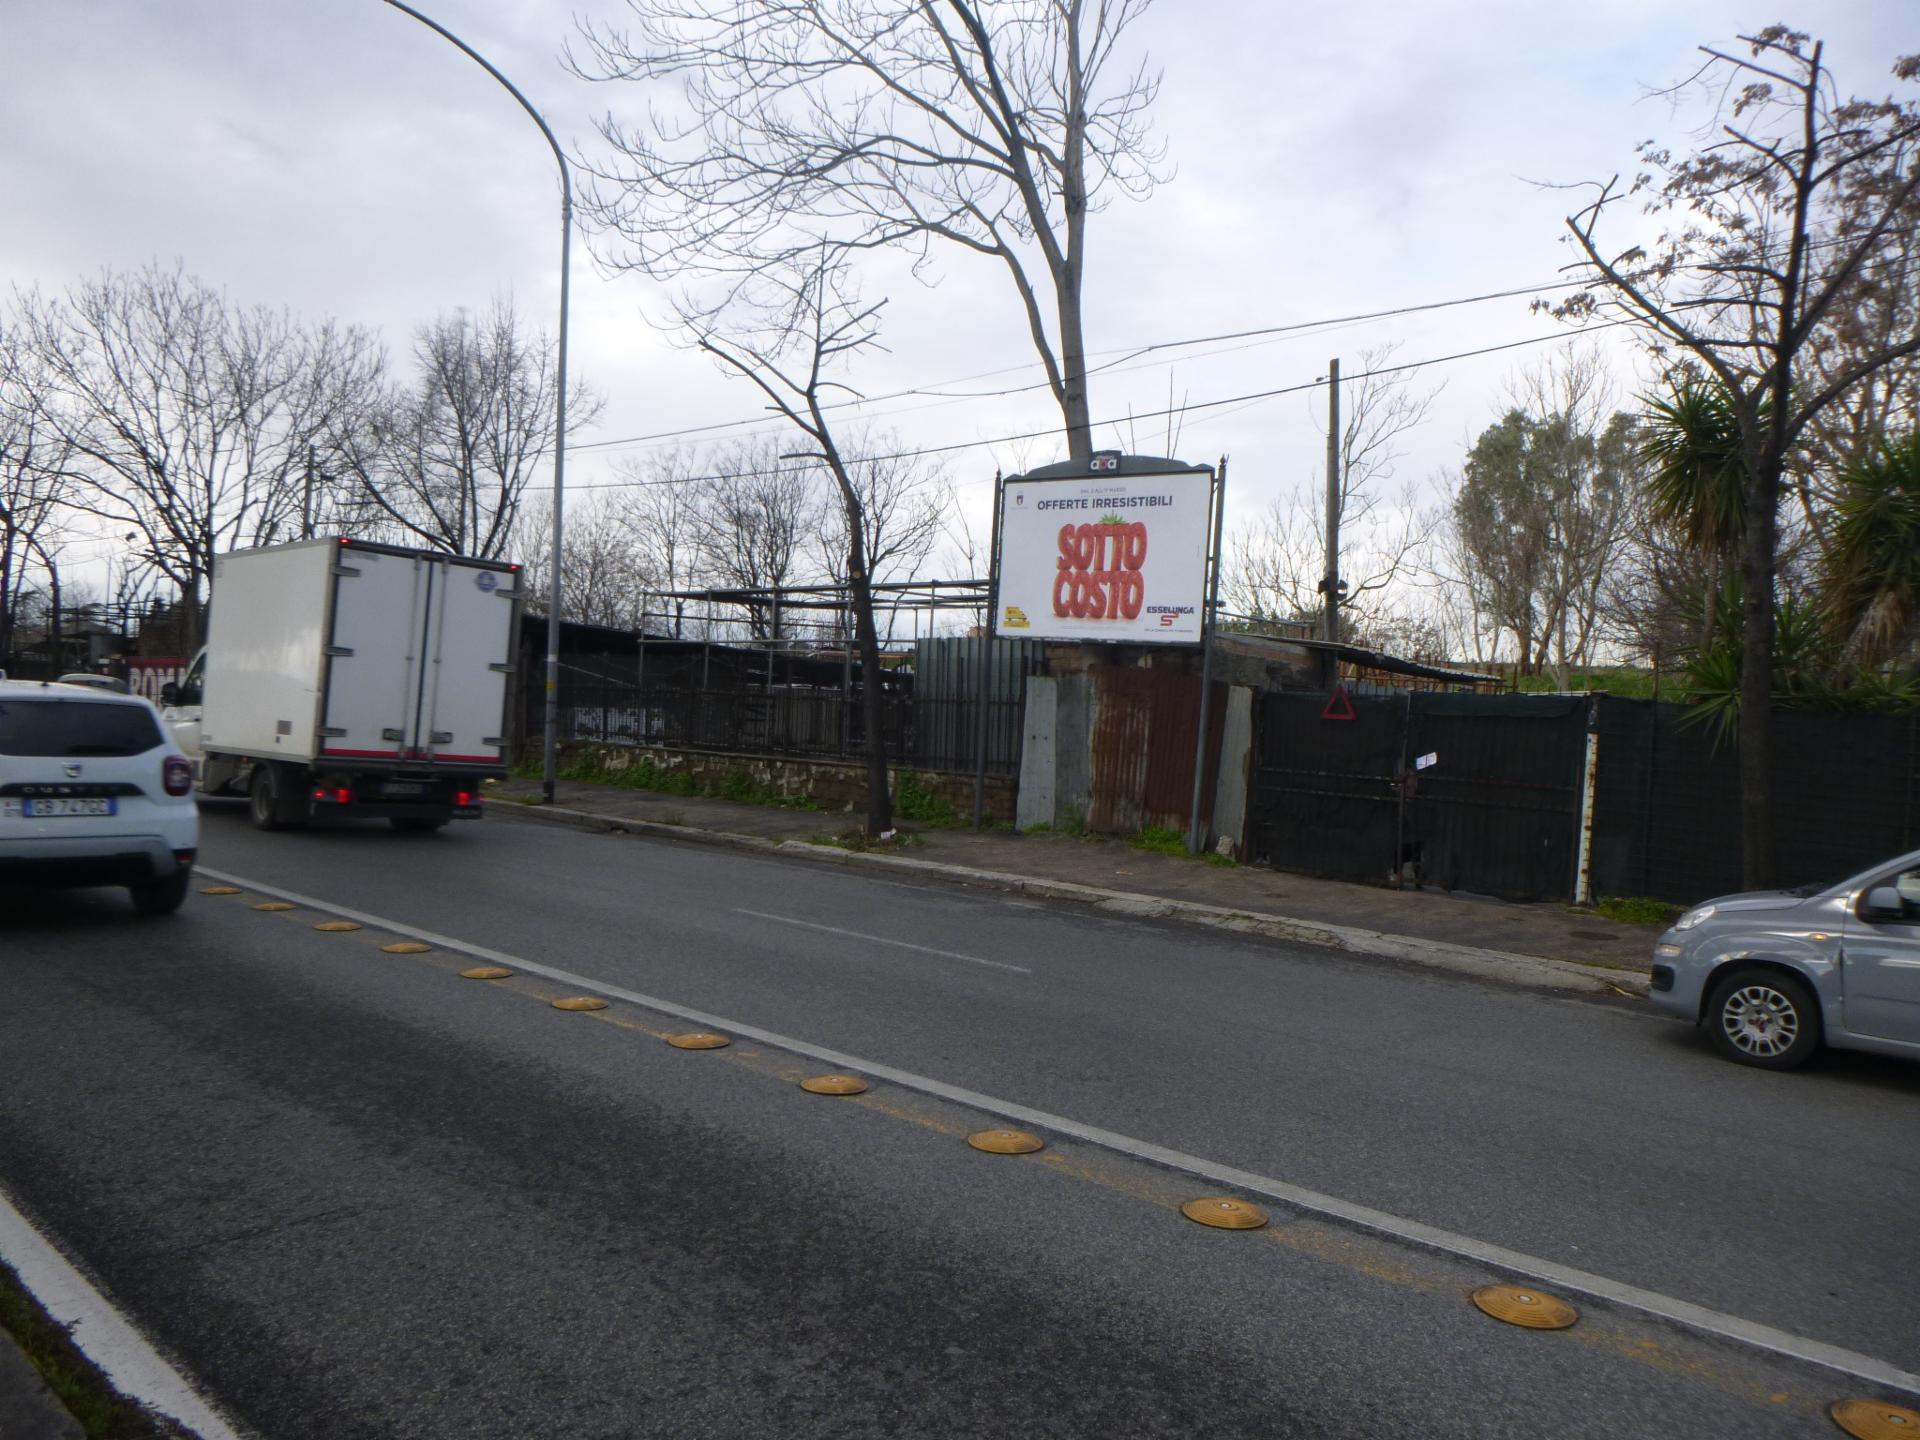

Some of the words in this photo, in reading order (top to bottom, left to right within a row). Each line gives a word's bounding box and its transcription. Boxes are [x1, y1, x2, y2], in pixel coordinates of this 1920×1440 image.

[1037, 499, 1089, 511] OFFERTE
[1092, 495, 1173, 509] IRRESISTIBILI
[1057, 521, 1147, 571] SOTTO
[1053, 570, 1144, 620] COSTO
[1147, 606, 1194, 615] ESSELUNGA
